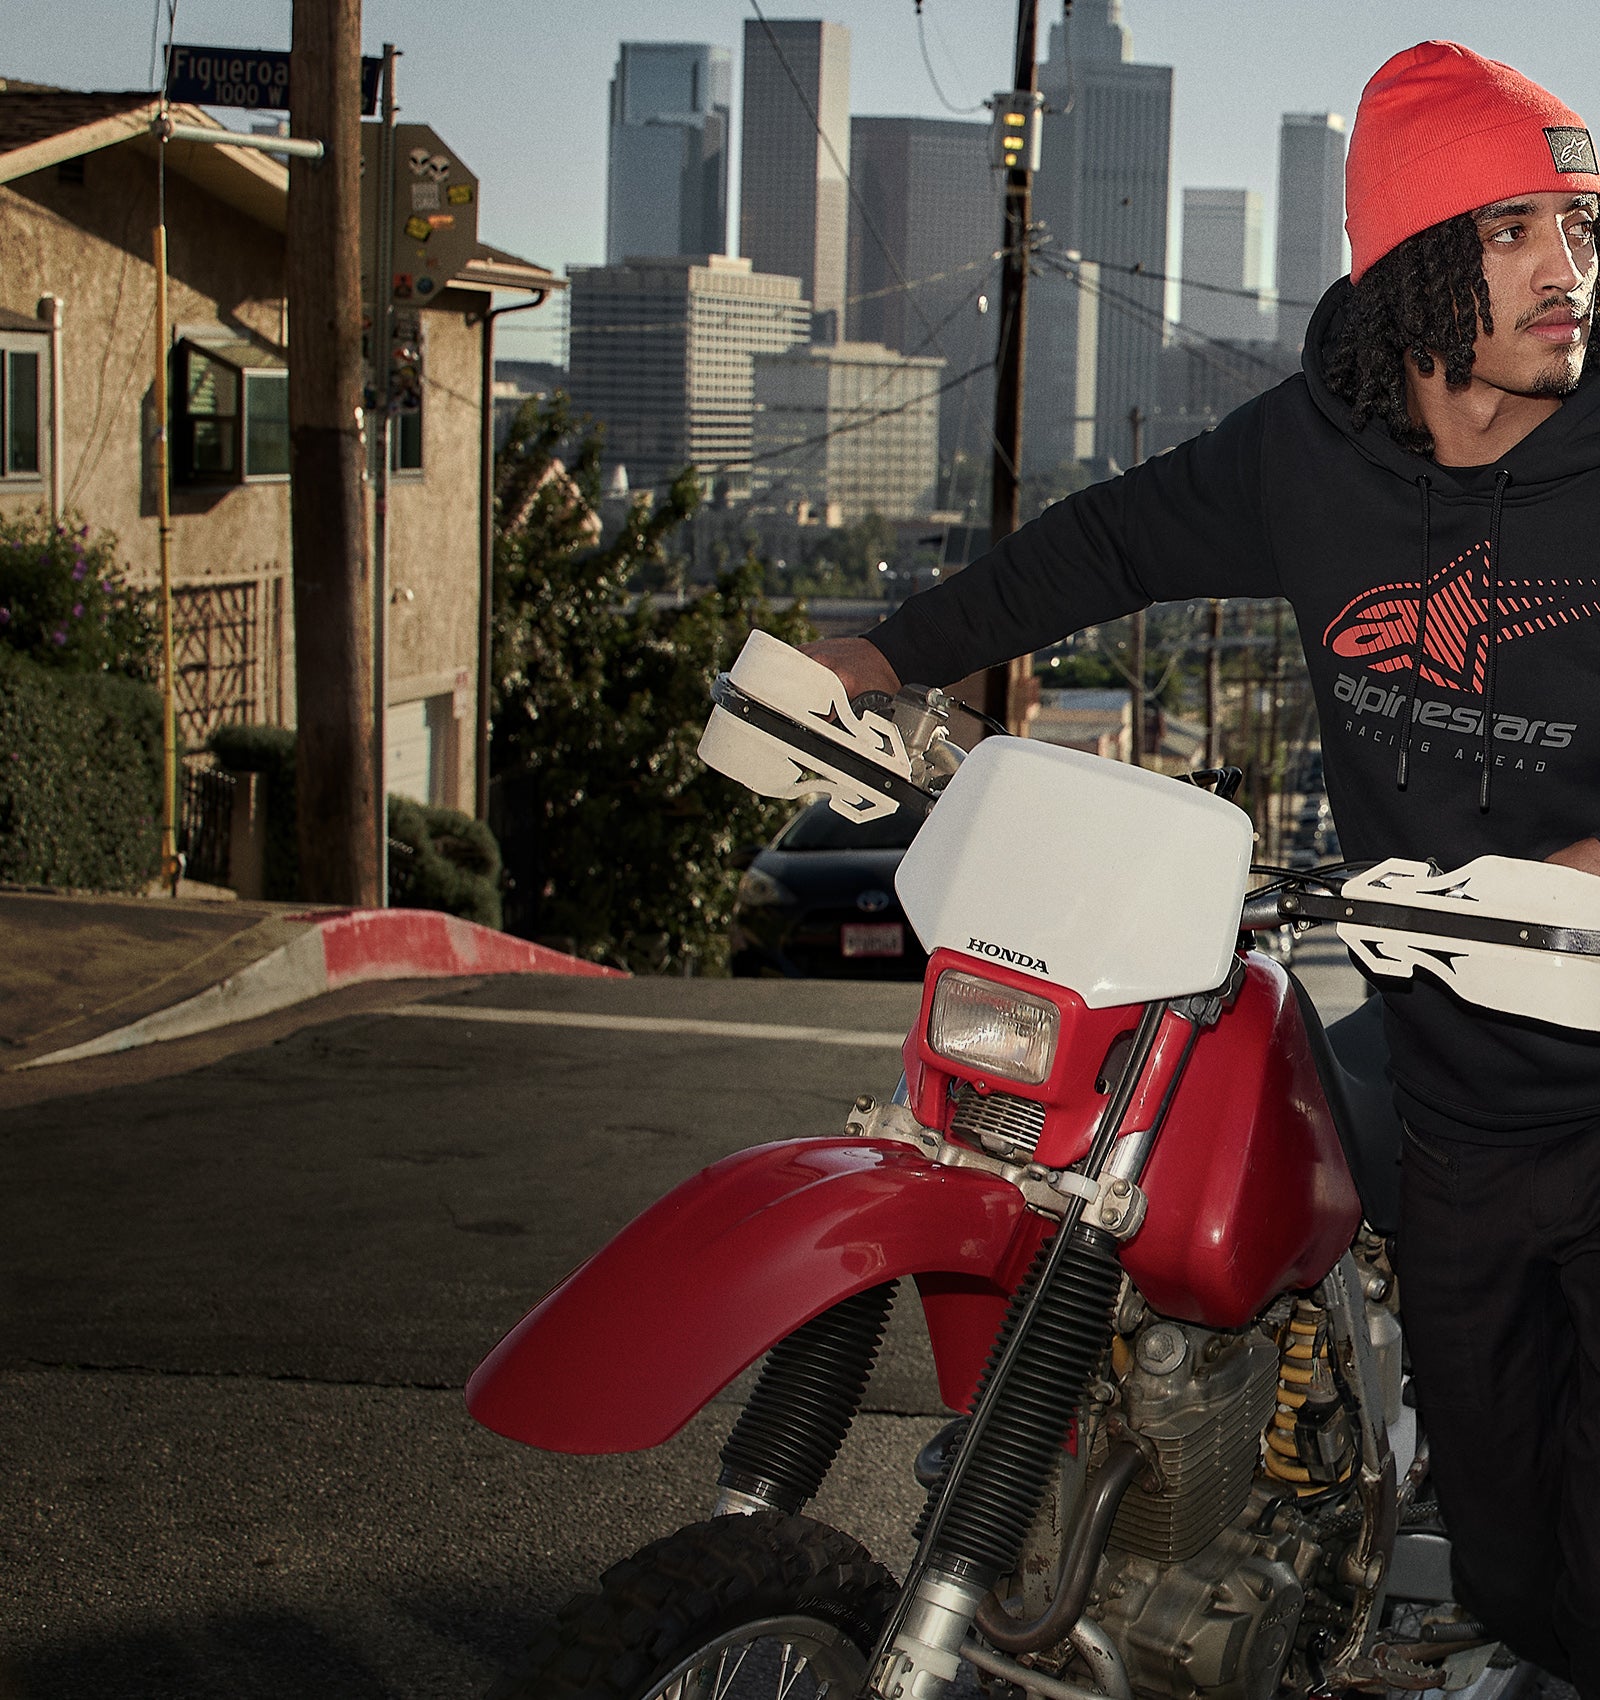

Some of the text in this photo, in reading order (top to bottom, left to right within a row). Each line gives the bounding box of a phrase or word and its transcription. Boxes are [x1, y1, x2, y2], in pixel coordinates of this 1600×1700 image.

[173, 50, 290, 91] Figueroa
[216, 82, 285, 107] 1000 W
[1345, 720, 1546, 772] RACIG AHEAD
[967, 937, 1050, 975] HONDA
